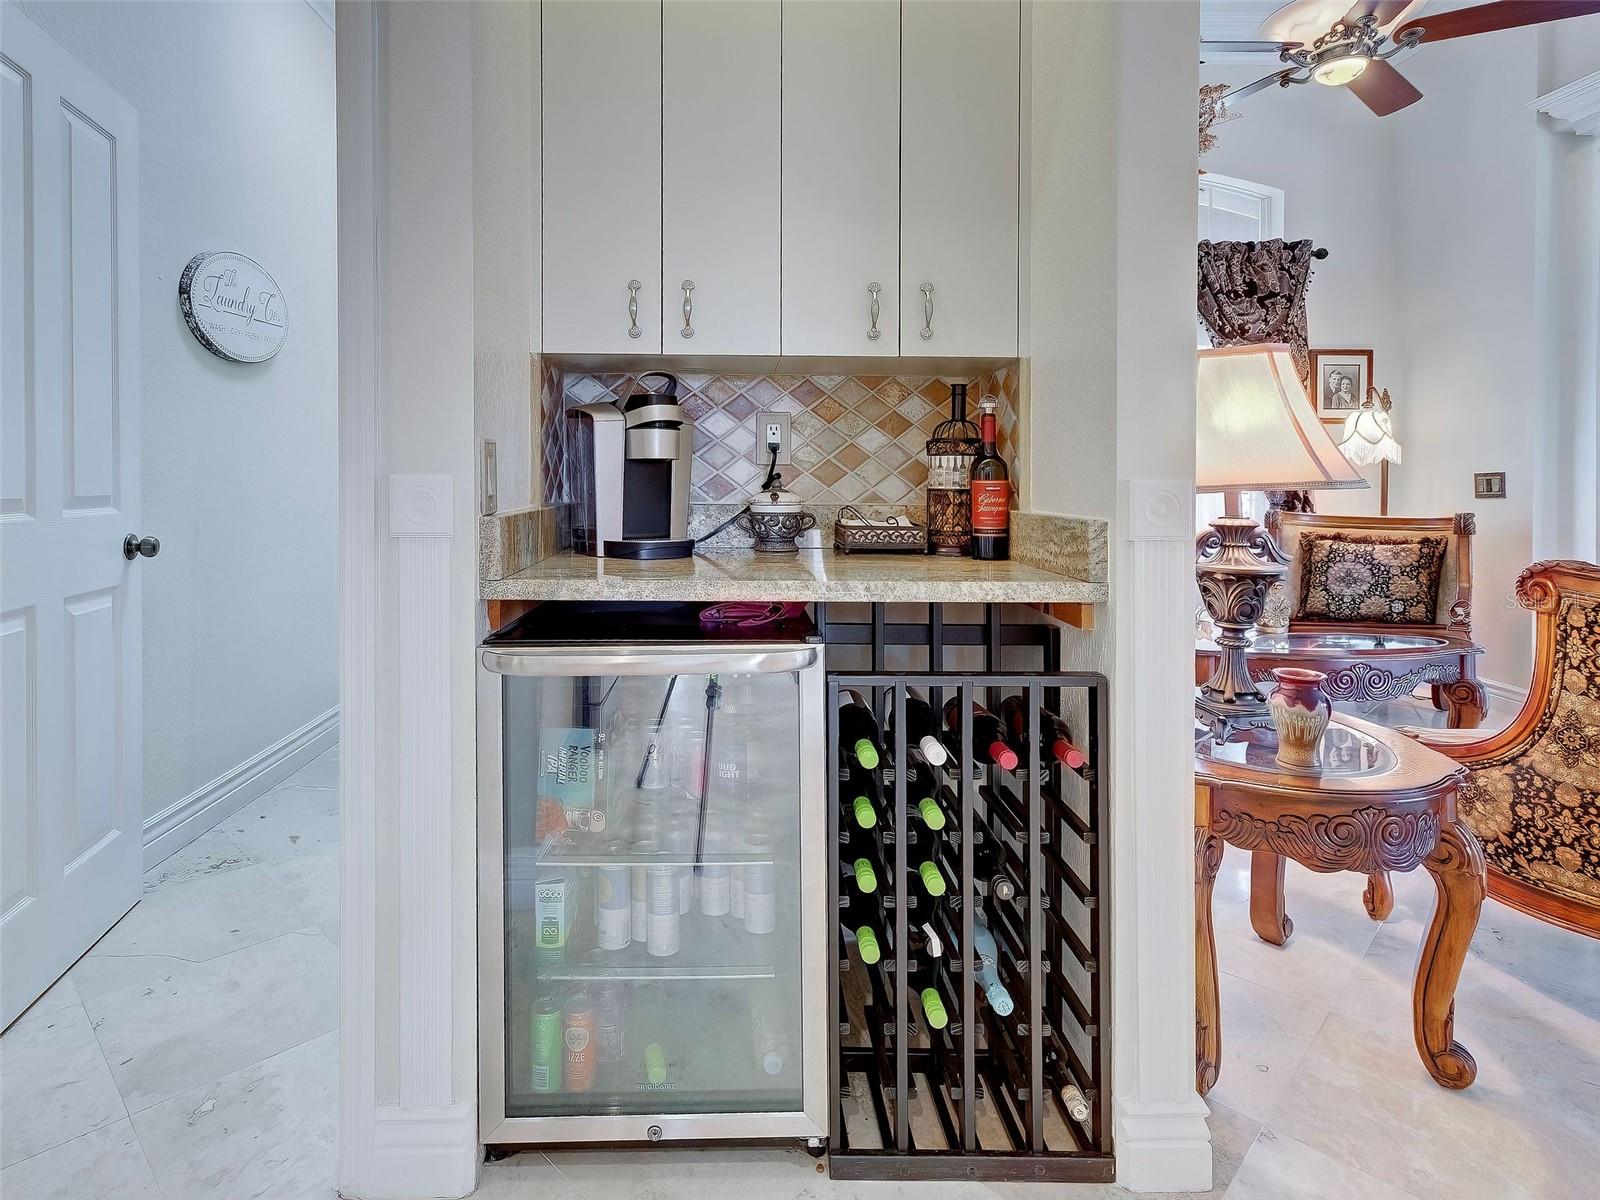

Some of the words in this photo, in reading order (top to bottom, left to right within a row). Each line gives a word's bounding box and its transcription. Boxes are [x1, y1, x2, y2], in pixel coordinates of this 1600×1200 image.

[546, 754, 558, 774] IPA
[557, 746, 568, 785] IMPERIAL
[567, 745, 579, 783] RANGER
[579, 745, 591, 784] VOODOO
[719, 770, 740, 779] IGHT
[568, 1052, 585, 1062] IZZE
